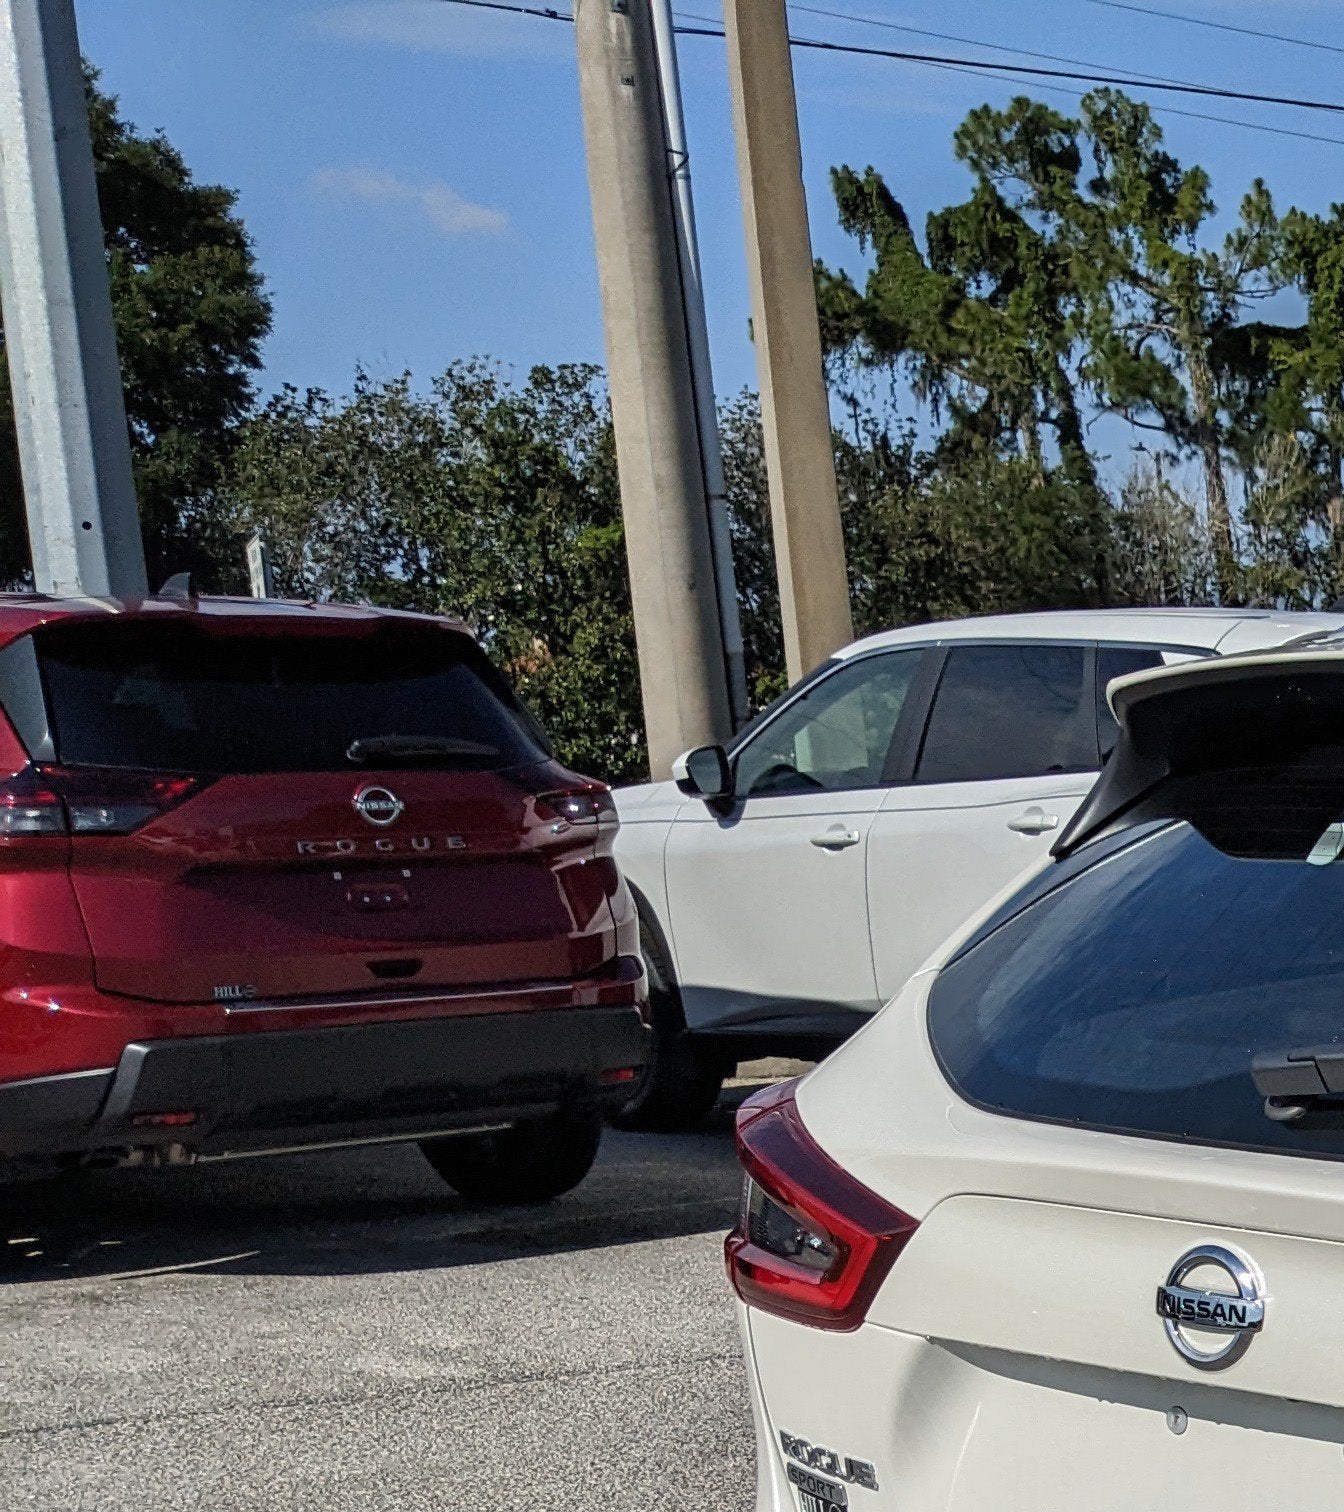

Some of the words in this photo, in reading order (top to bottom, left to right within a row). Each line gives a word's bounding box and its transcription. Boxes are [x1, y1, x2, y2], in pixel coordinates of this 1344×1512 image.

[297, 835, 466, 854] ROGUE
[1161, 1293, 1248, 1323] NISSAN
[790, 1466, 836, 1500] SPORT
